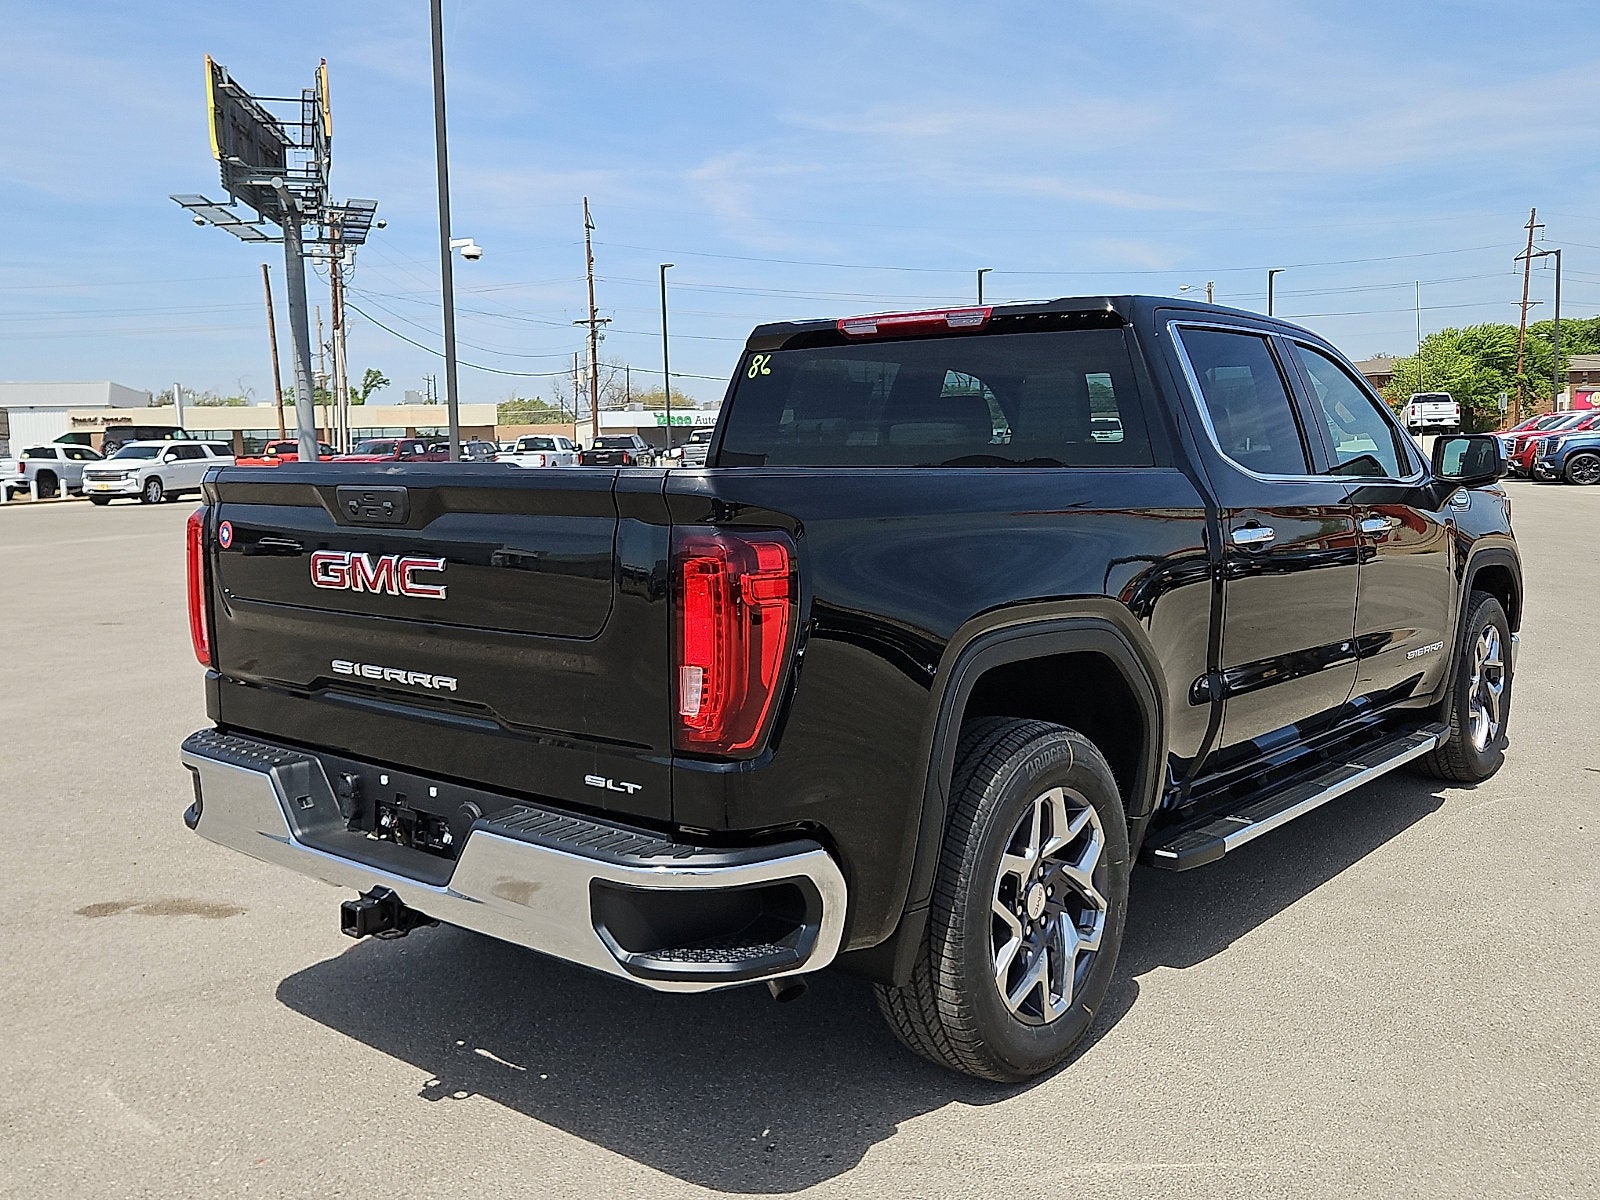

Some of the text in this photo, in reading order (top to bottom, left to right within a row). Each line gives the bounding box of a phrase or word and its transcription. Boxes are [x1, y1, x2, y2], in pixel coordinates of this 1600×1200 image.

[748, 354, 771, 378] 86
[310, 550, 448, 600] GMC
[1407, 641, 1444, 659] SIERRA
[331, 659, 458, 691] SIERRA
[584, 774, 643, 794] SLT
